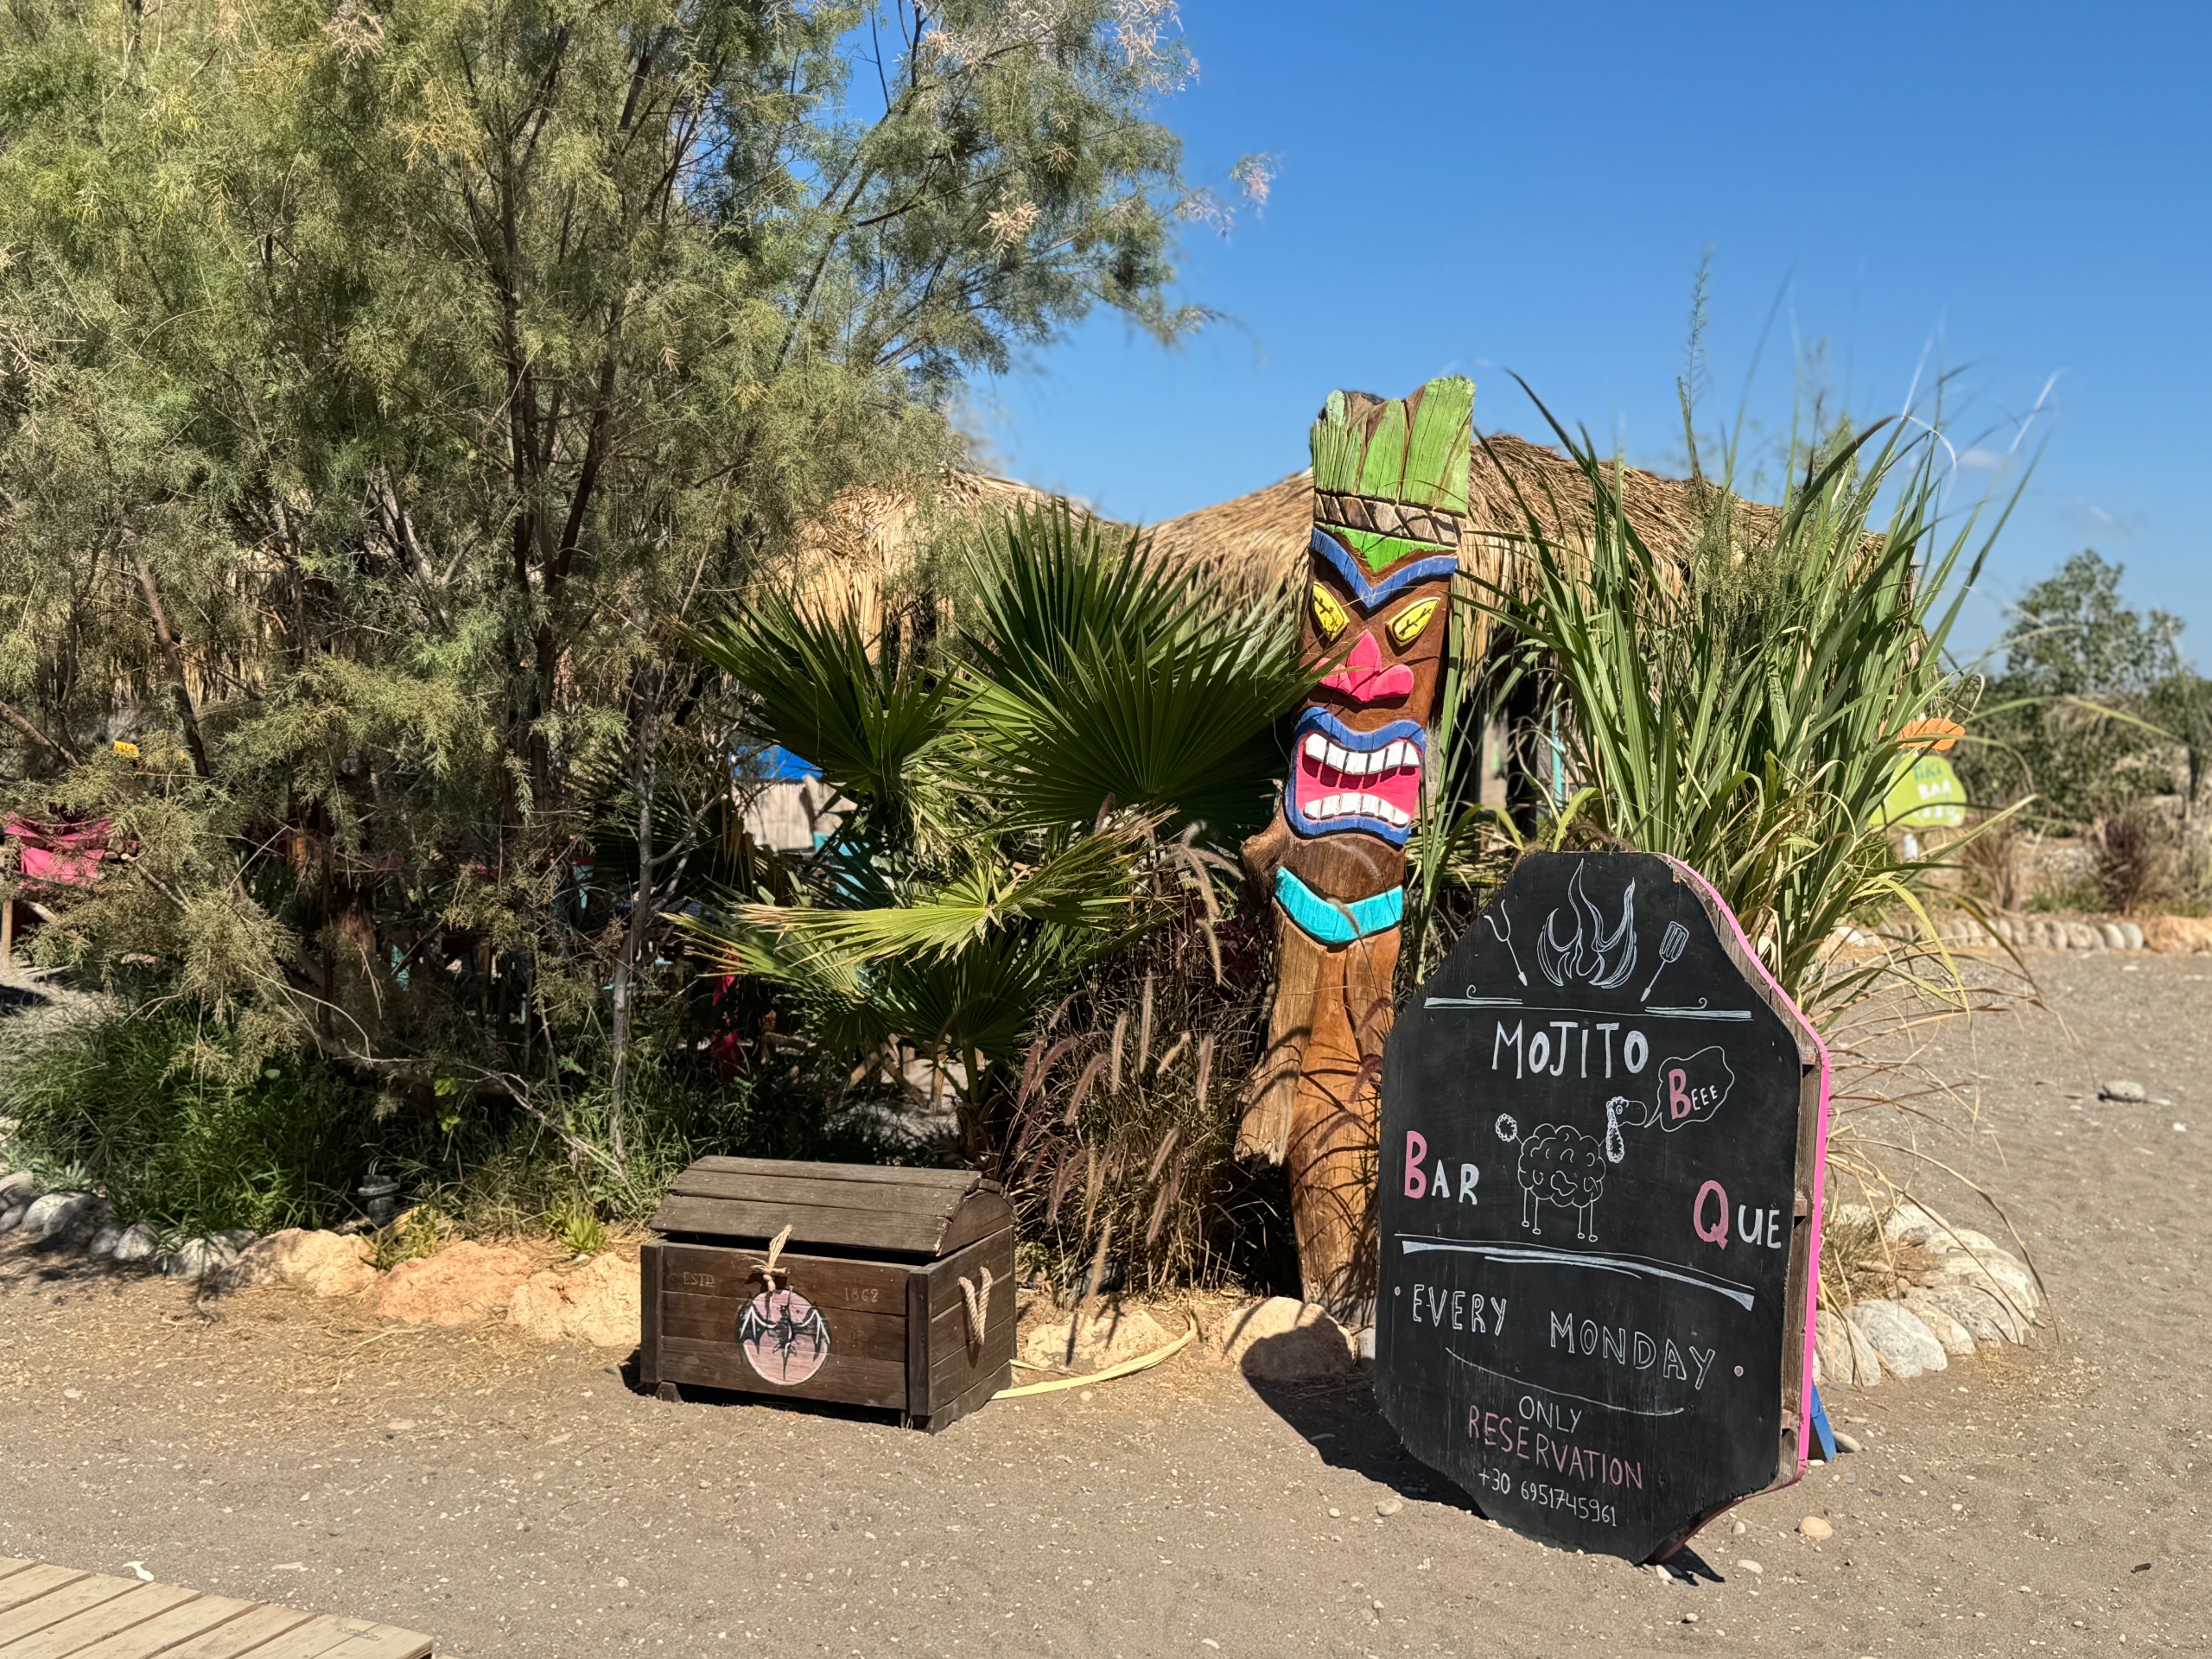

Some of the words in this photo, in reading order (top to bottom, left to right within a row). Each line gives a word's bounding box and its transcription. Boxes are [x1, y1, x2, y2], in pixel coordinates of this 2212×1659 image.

[1492, 1020, 1649, 1079] MOJITO
[844, 1287, 880, 1303] 1862
[1412, 1283, 1507, 1336] EVERY
[1550, 1311, 1716, 1390] MONDAY
[1518, 1395, 1582, 1433] ONLY
[1469, 1405, 1643, 1489] RESERVATION
[1478, 1468, 1511, 1495] +30
[1521, 1478, 1618, 1527] 6951745961
